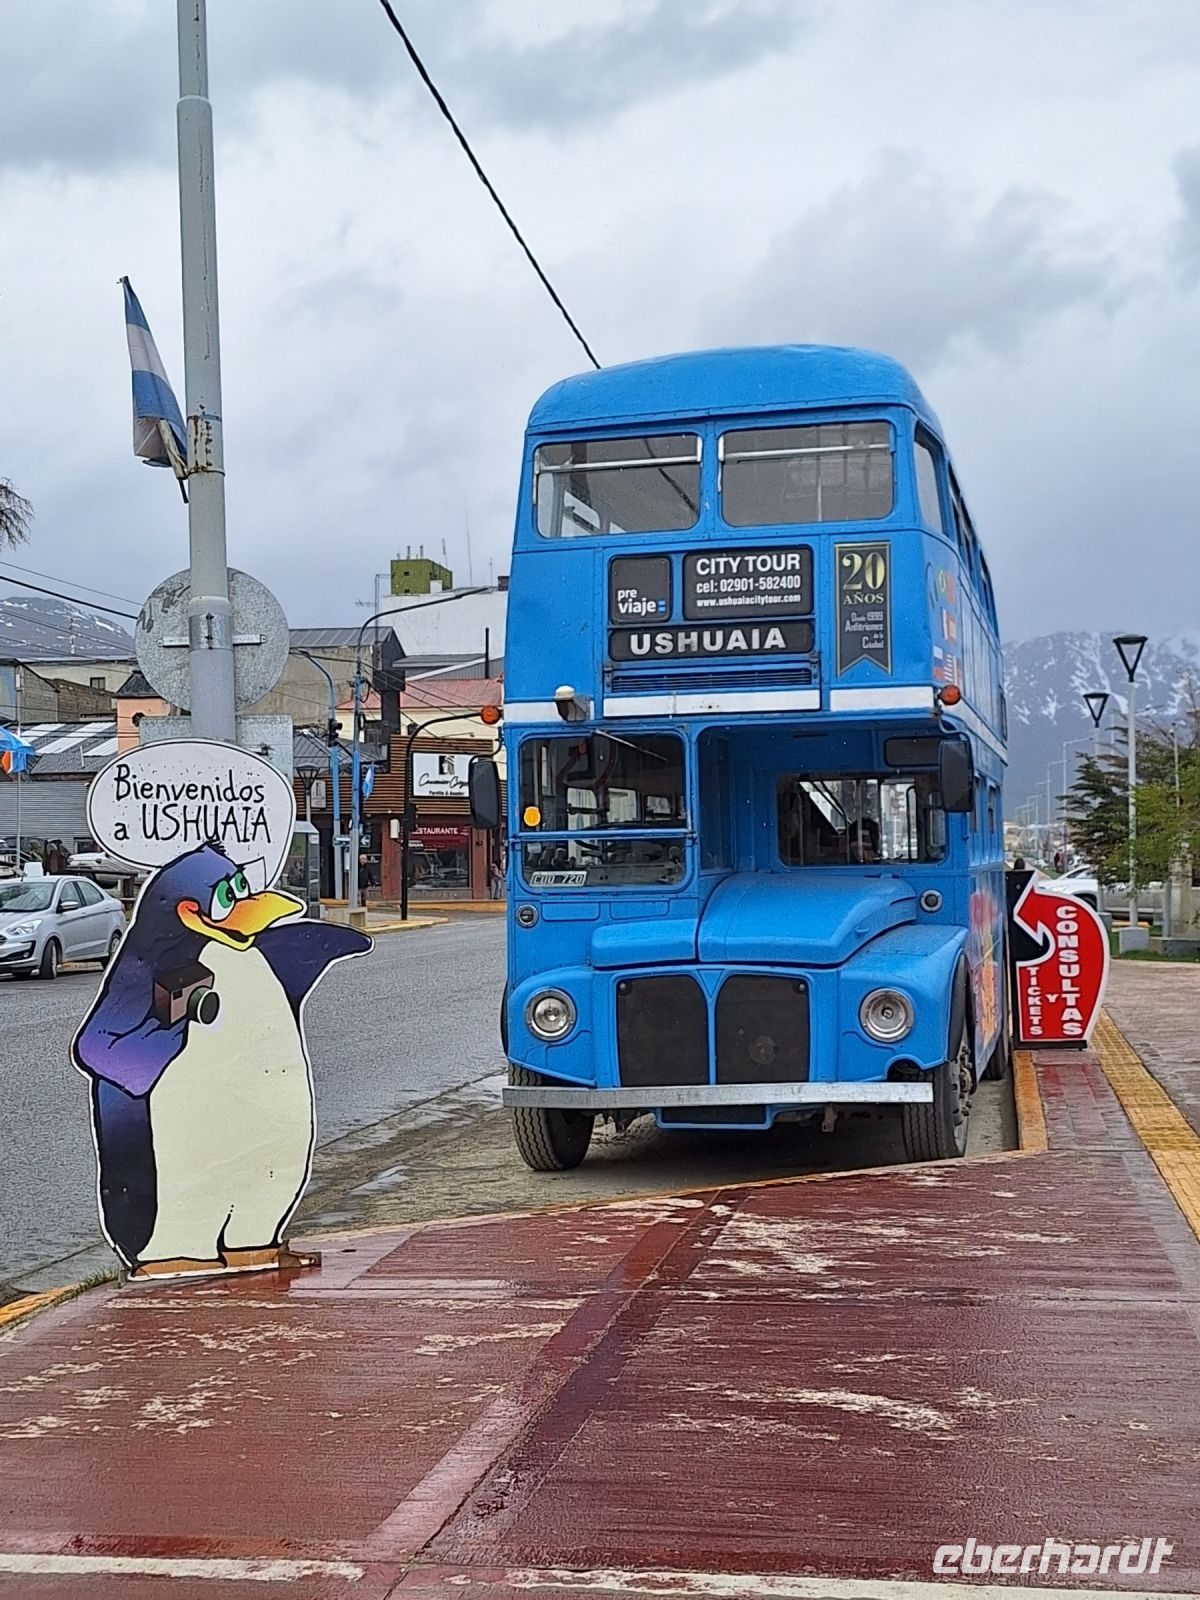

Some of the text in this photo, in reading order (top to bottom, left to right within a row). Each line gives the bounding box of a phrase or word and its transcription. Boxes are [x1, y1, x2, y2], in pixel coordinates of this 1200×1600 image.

[696, 553, 801, 575] CITY TOUR
[842, 552, 885, 590] 20
[617, 589, 637, 601] pre
[696, 575, 801, 593] cel: 02901-582400
[696, 594, 801, 607] www.ushuaiacitytour.com
[842, 591, 885, 605] AÑOS
[630, 627, 786, 655] USHUAIA
[114, 763, 265, 803] Bienvenidos
[114, 803, 271, 844] a USHUAIA
[1056, 905, 1083, 1036] CONSULTAS
[1026, 966, 1043, 1036] TICKETS
[1045, 993, 1059, 1003] Y
